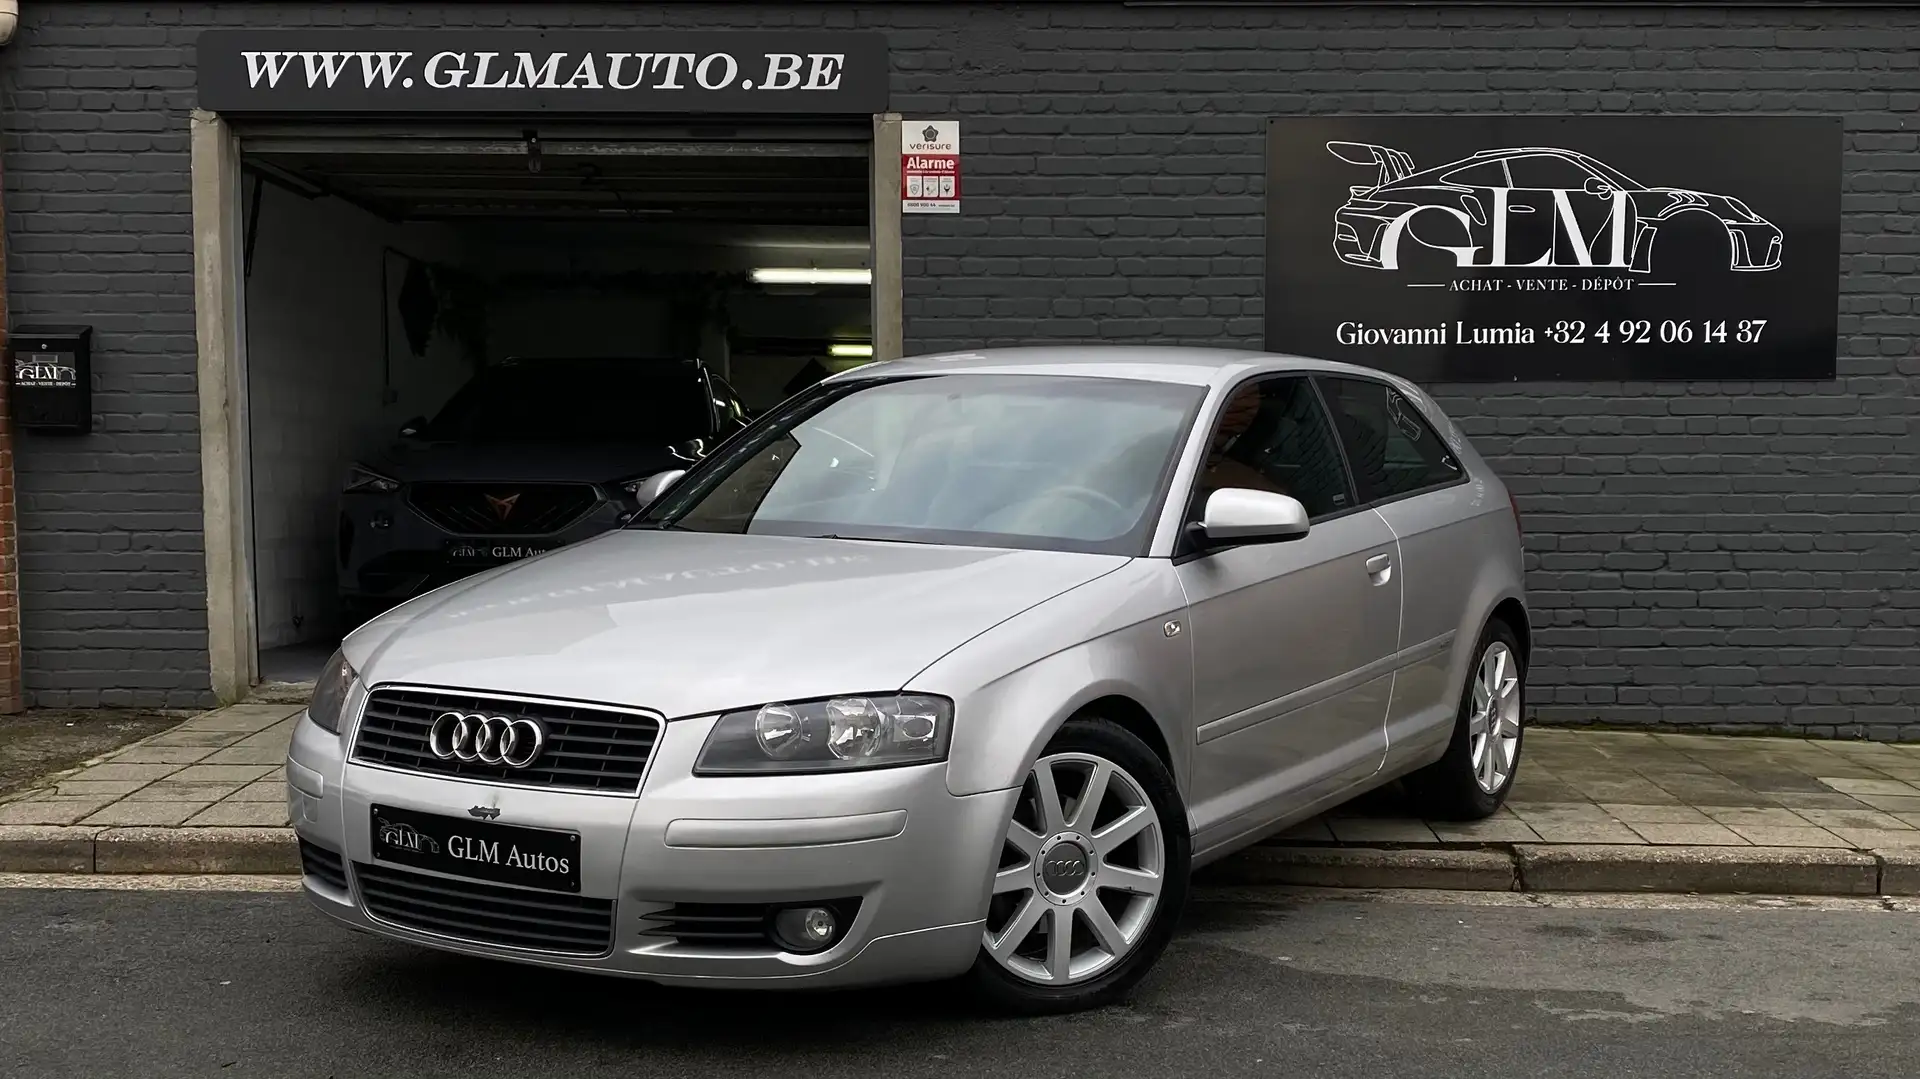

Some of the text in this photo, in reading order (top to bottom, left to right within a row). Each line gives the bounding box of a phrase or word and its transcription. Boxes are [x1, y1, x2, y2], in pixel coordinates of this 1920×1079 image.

[240, 51, 845, 91] WWW.GLMAUTO.BE
[907, 156, 955, 169] Alarme
[1449, 279, 1503, 291] ACHAT
[1516, 279, 1568, 291] VENTE
[1582, 276, 1635, 291] DÉPÔT
[1336, 319, 1768, 345] Giovanni Lumia +32 4 92 06 14 37
[492, 546, 522, 558] GLM
[447, 835, 570, 874] GLM Autos
